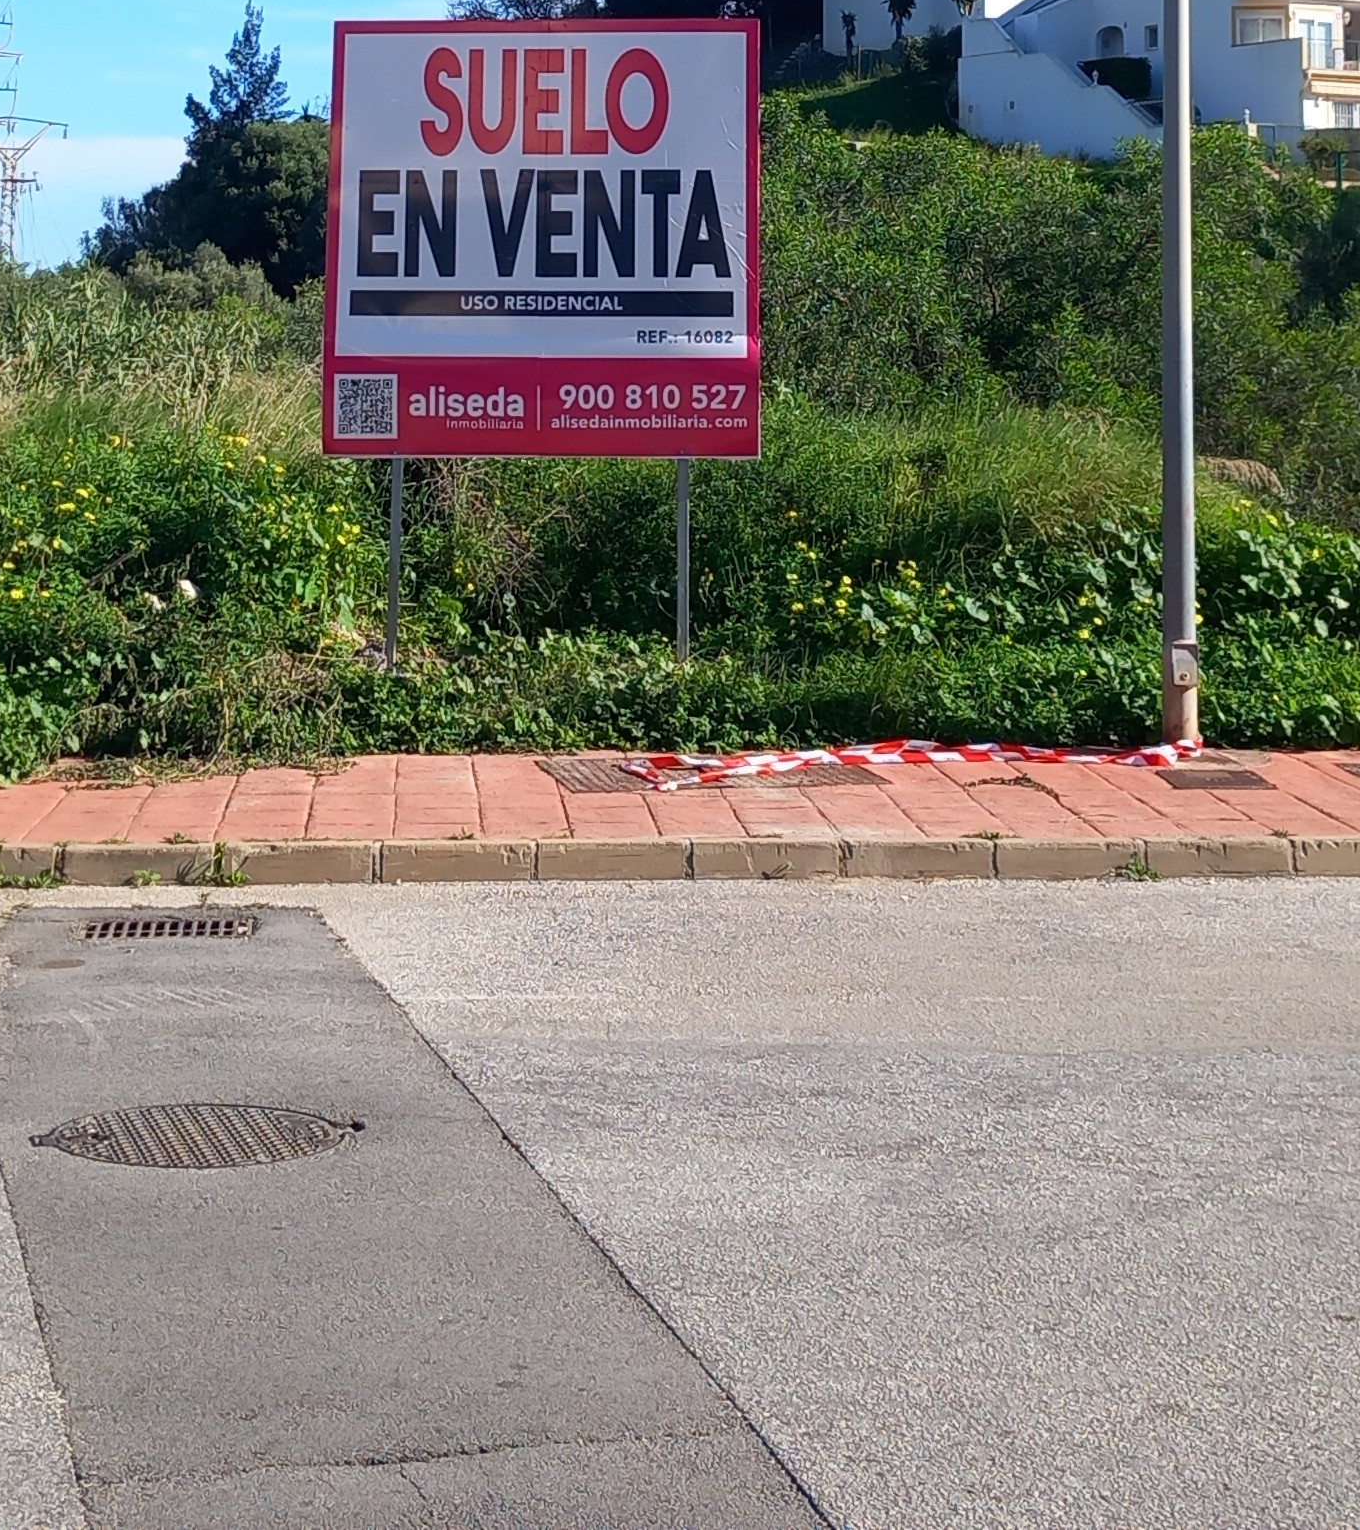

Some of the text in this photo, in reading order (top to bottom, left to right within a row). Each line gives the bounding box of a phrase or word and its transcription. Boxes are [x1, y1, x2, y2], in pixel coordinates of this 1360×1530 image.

[420, 47, 670, 157] SUELO
[356, 169, 733, 278] EN VENTA
[460, 295, 623, 311] USO RESIDENCIAL
[685, 330, 734, 344] 16082
[408, 387, 525, 417] aliseda
[558, 384, 747, 410] 900 810 527
[551, 415, 748, 429] alisedainmobiliaria.com
